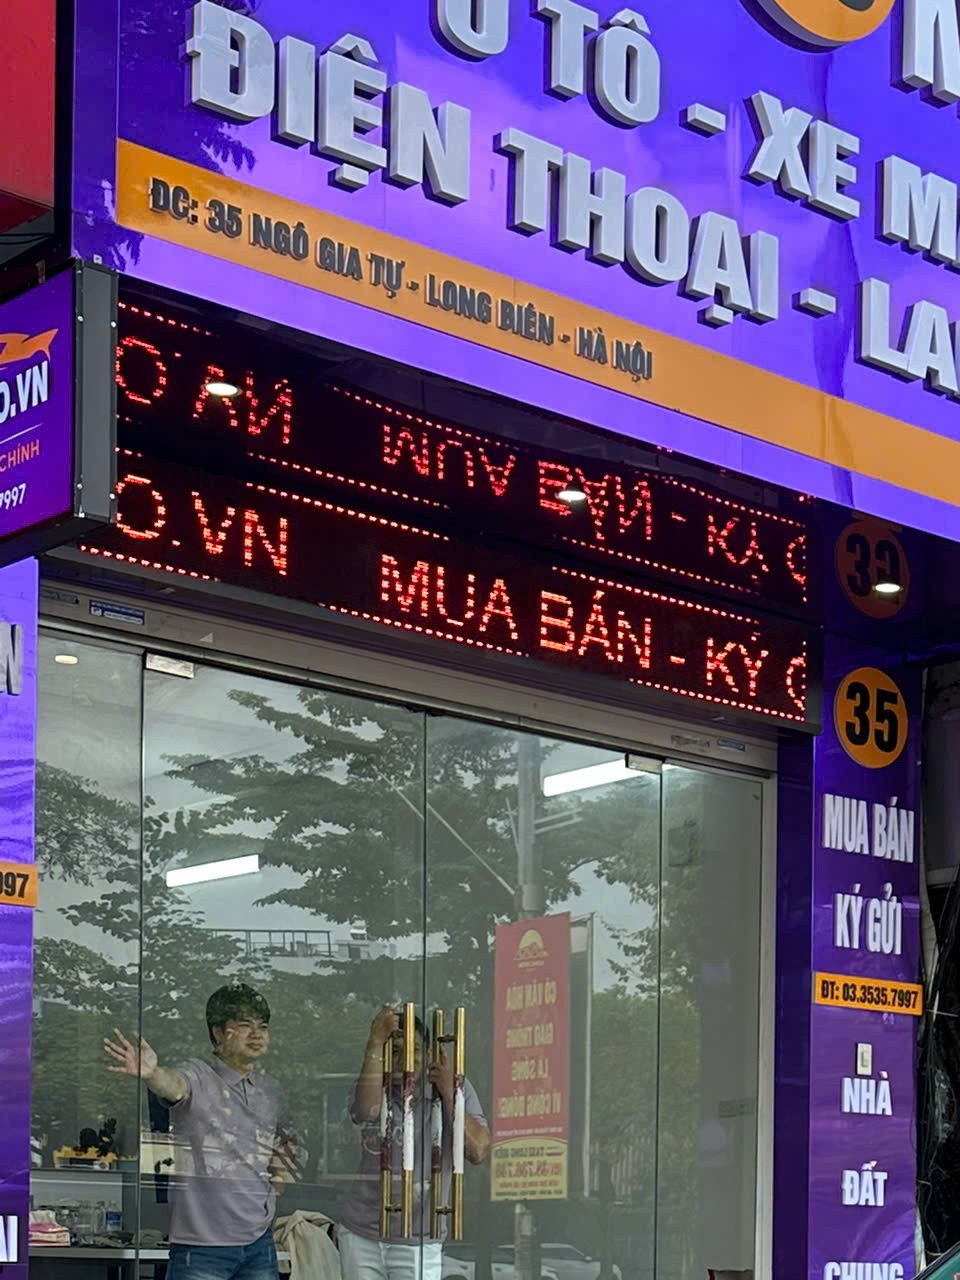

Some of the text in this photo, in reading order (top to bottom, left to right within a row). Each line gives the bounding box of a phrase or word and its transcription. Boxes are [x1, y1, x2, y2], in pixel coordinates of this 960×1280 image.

[538, 0, 660, 125] TÔ
[743, 90, 860, 221] XE
[185, 4, 471, 205] ĐIỆN
[498, 127, 779, 327] THOẠI
[149, 177, 199, 225] ĐC:
[205, 199, 243, 238] 35
[249, 213, 309, 261] NGÔ
[316, 237, 363, 281] GIA
[367, 252, 405, 299] TỰ
[425, 273, 492, 324] LONG
[497, 298, 554, 345] BIÊN
[575, 327, 608, 364] HÀ
[611, 340, 652, 382] NỘI
[381, 553, 518, 640] MUA
[539, 589, 652, 668] BÁN
[706, 632, 769, 696] KÝ
[845, 682, 899, 754] 35
[823, 793, 915, 863] MUA BÁN
[834, 882, 903, 956] KÝ GỬI
[820, 980, 919, 1010] ĐT: 03.3535.7997
[841, 1071, 893, 1116] NHÀ
[841, 1160, 888, 1207] ĐẤT
